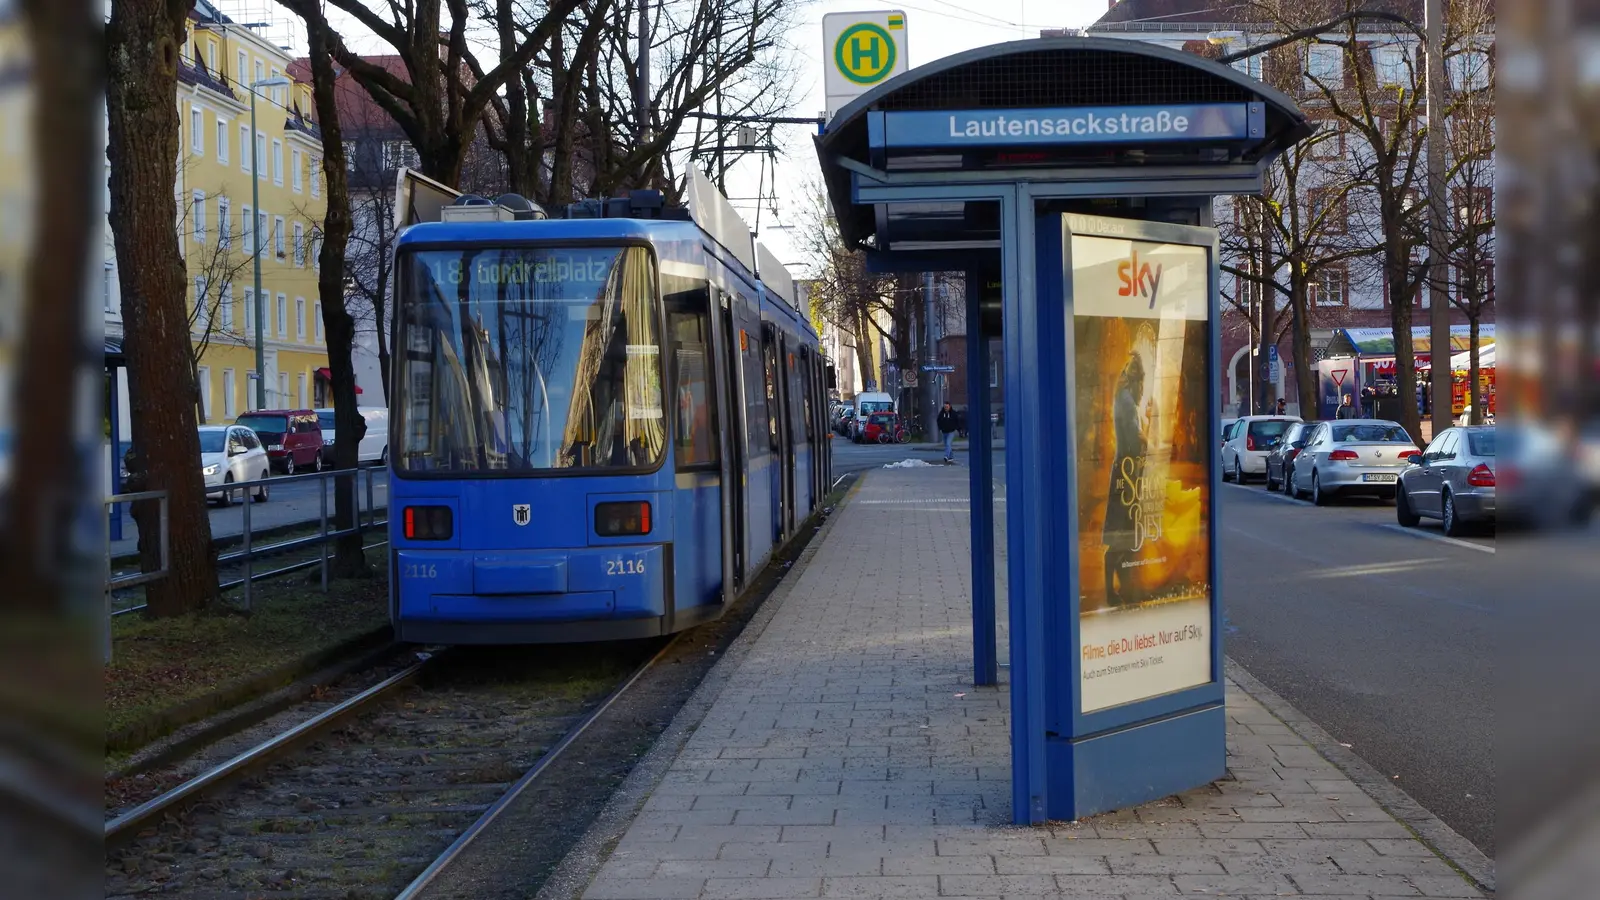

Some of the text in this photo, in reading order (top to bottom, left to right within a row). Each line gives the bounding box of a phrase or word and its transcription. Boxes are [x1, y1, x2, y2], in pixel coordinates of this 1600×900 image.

[851, 37, 880, 71] H
[949, 110, 1189, 138] Lautensackstraße
[434, 256, 607, 285] 18 Gondrellplatz
[1117, 249, 1162, 310] sky
[404, 564, 437, 579] 2116
[606, 559, 645, 576] 2116
[1082, 644, 1106, 661] Filme,
[1107, 639, 1120, 656] die
[1121, 638, 1133, 653] Du
[1134, 633, 1158, 651] liebst.
[1158, 630, 1173, 646] Nur
[1174, 625, 1187, 642] auf
[1082, 670, 1096, 680] Auch
[1096, 668, 1107, 678] zum
[1107, 663, 1131, 675] Streamen
[1131, 661, 1140, 671] mit
